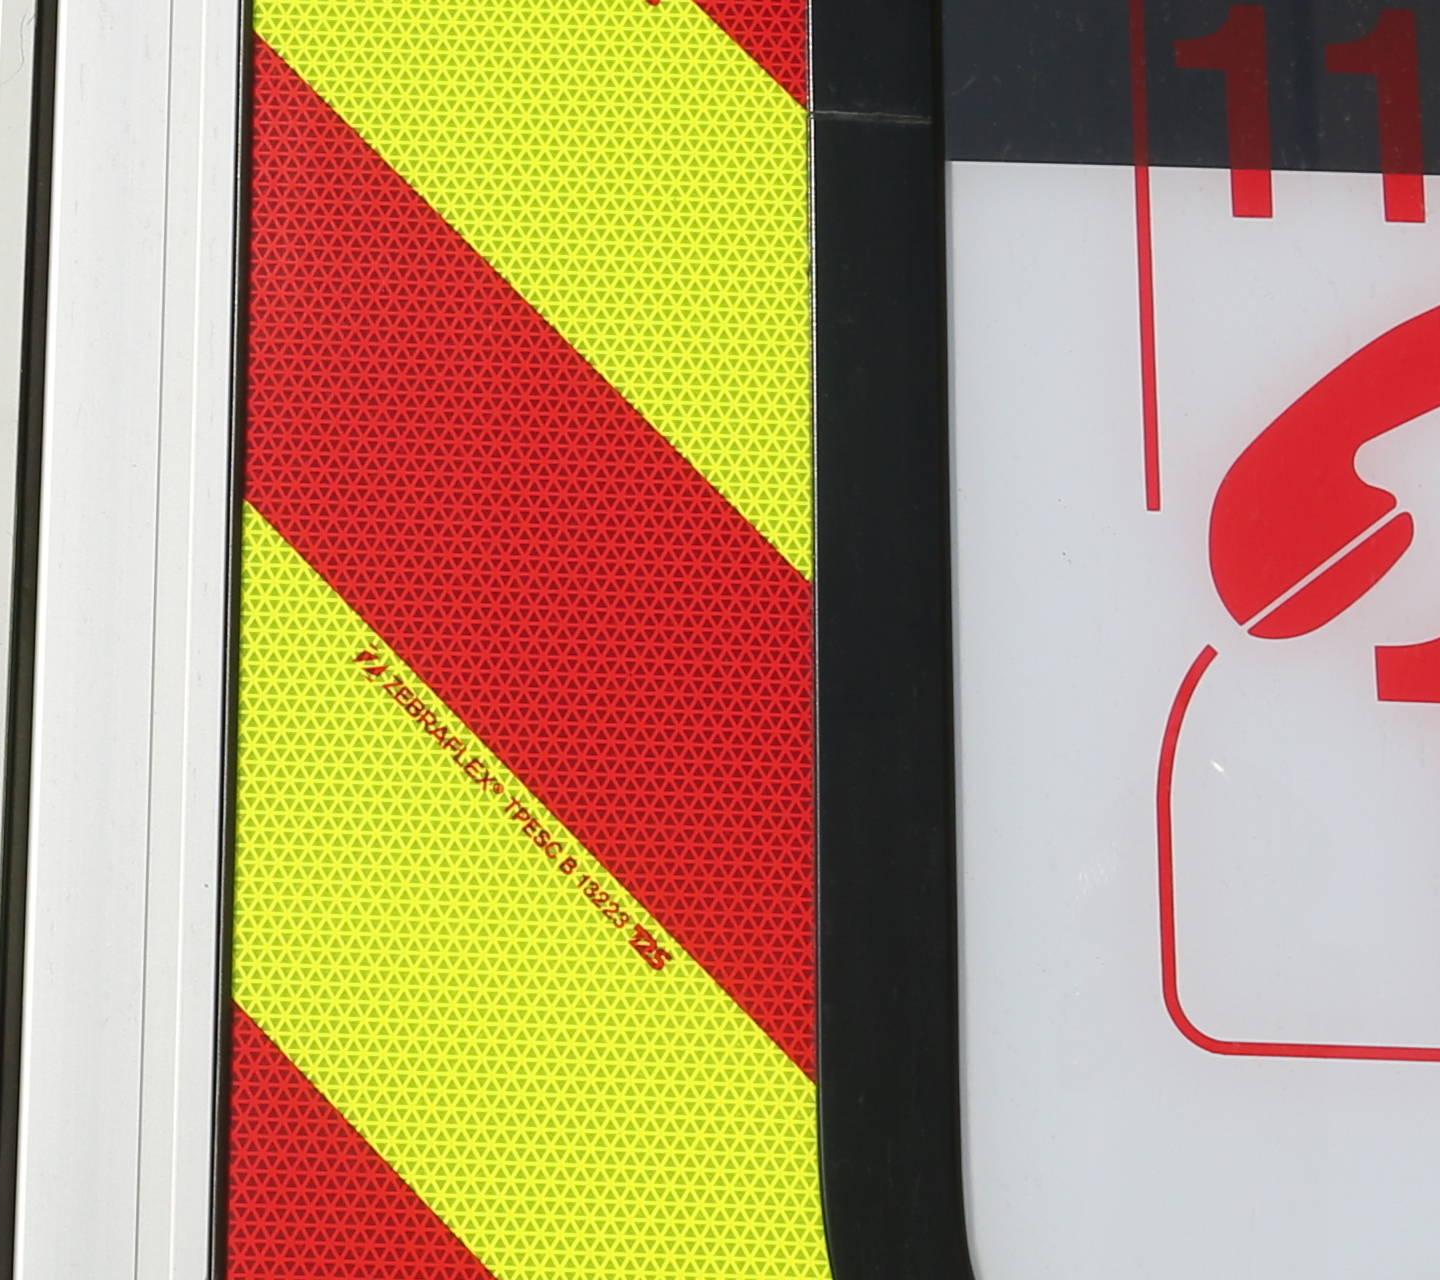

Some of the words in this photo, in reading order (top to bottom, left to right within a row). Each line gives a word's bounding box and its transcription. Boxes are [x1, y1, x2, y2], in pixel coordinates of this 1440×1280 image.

[503, 796, 563, 860] TPESC
[559, 855, 579, 876] B
[576, 873, 632, 930] 13223
